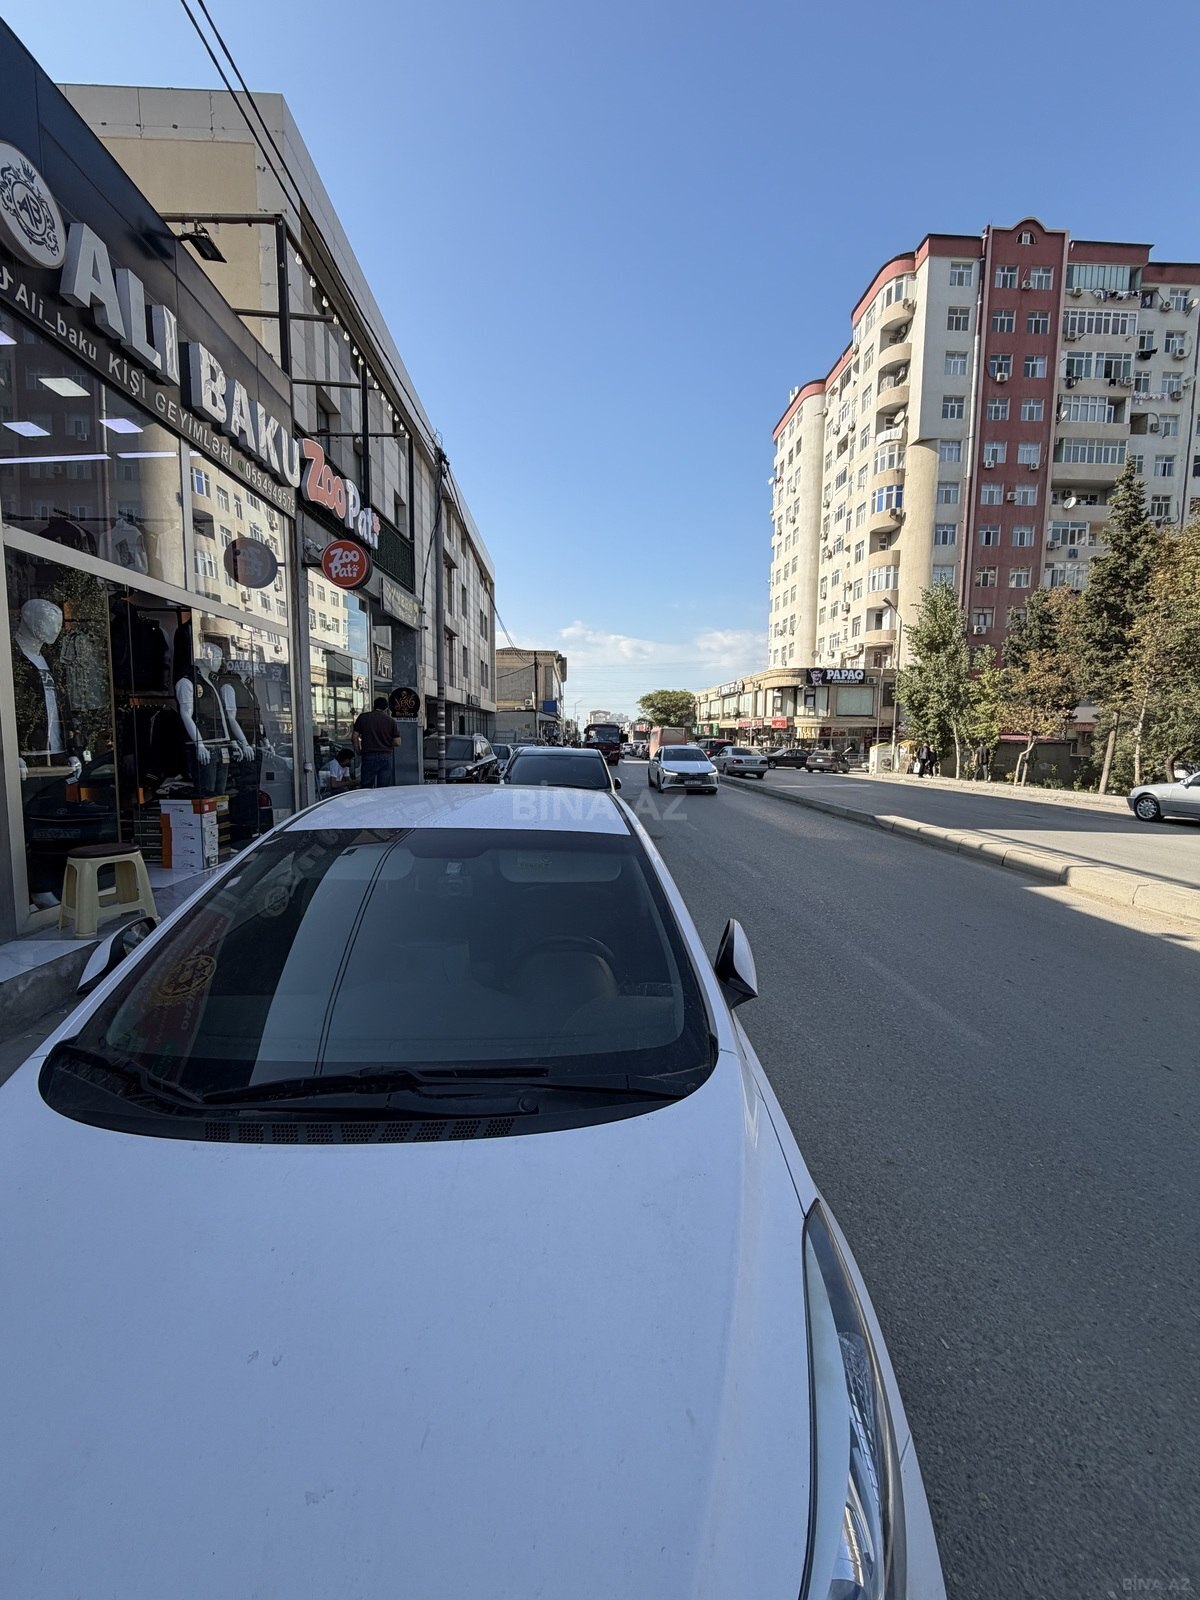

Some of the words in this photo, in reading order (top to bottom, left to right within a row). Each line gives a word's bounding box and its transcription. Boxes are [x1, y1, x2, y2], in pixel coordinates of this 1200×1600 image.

[15, 283, 97, 361] Ali_baku
[189, 342, 300, 488] BAKU
[826, 669, 864, 680] PAPAQ
